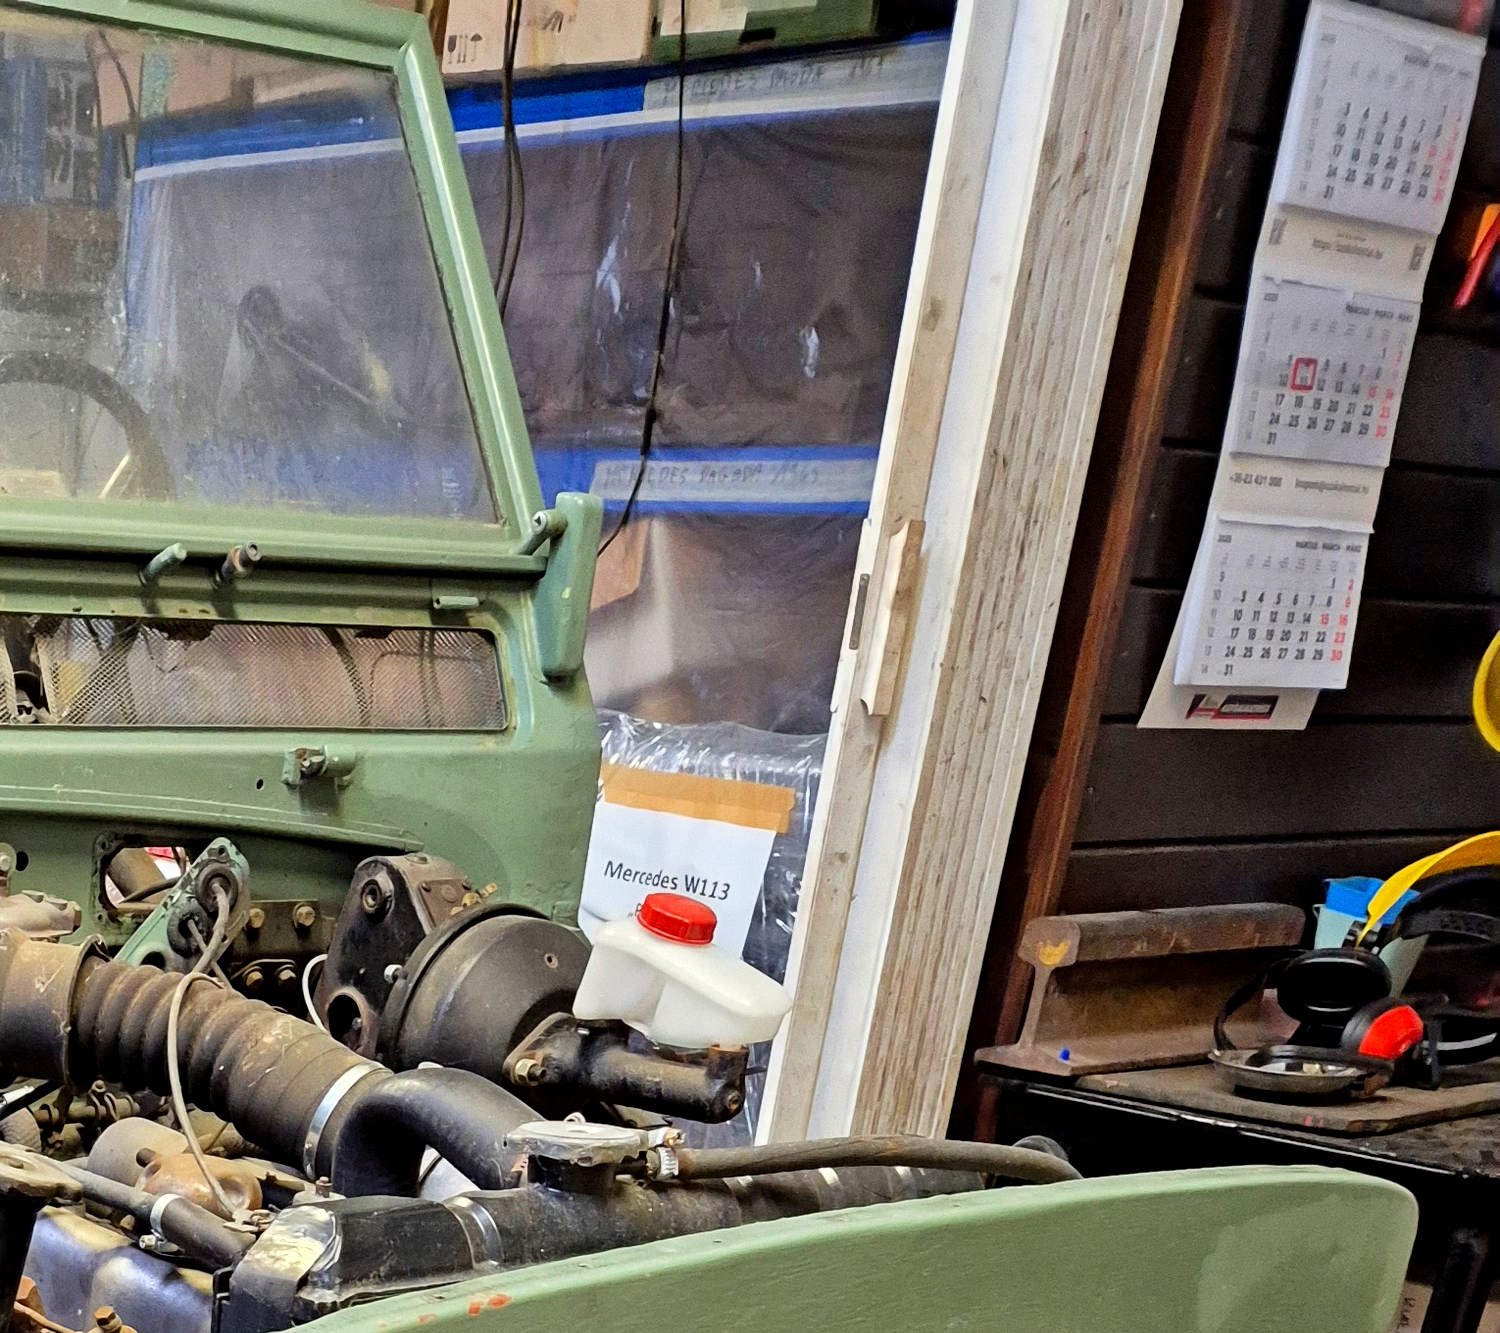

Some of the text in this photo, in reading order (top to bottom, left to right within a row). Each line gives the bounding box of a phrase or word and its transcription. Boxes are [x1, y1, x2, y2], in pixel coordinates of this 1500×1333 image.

[1240, 590, 1247, 603] 3
[1258, 591, 1265, 603] 4
[1276, 593, 1282, 605] 5
[1293, 594, 1299, 606] 6
[1309, 595, 1315, 607] 7
[1326, 595, 1333, 607] 8
[1233, 609, 1243, 621] 10
[1253, 610, 1260, 622] 11
[1270, 611, 1278, 623] 12
[1286, 612, 1295, 623] 13
[1303, 613, 1312, 624] 14
[1320, 613, 1329, 625] 15
[1339, 614, 1348, 626] 16
[1231, 627, 1240, 639] 17
[1248, 628, 1256, 640] 18
[1266, 629, 1275, 641] 19
[1280, 630, 1291, 642] 20
[1299, 631, 1308, 642] 21
[1316, 631, 1326, 643] 22
[1334, 632, 1346, 643] 23
[1225, 646, 1236, 658] 24
[1243, 647, 1253, 658] 25
[1260, 647, 1271, 659] 26
[1277, 648, 1288, 659] 27
[1294, 648, 1305, 660] 28
[1312, 649, 1323, 661] 29
[1330, 649, 1342, 662] 30
[1224, 664, 1233, 676] 31
[604, 860, 730, 900] Mercedes W113
